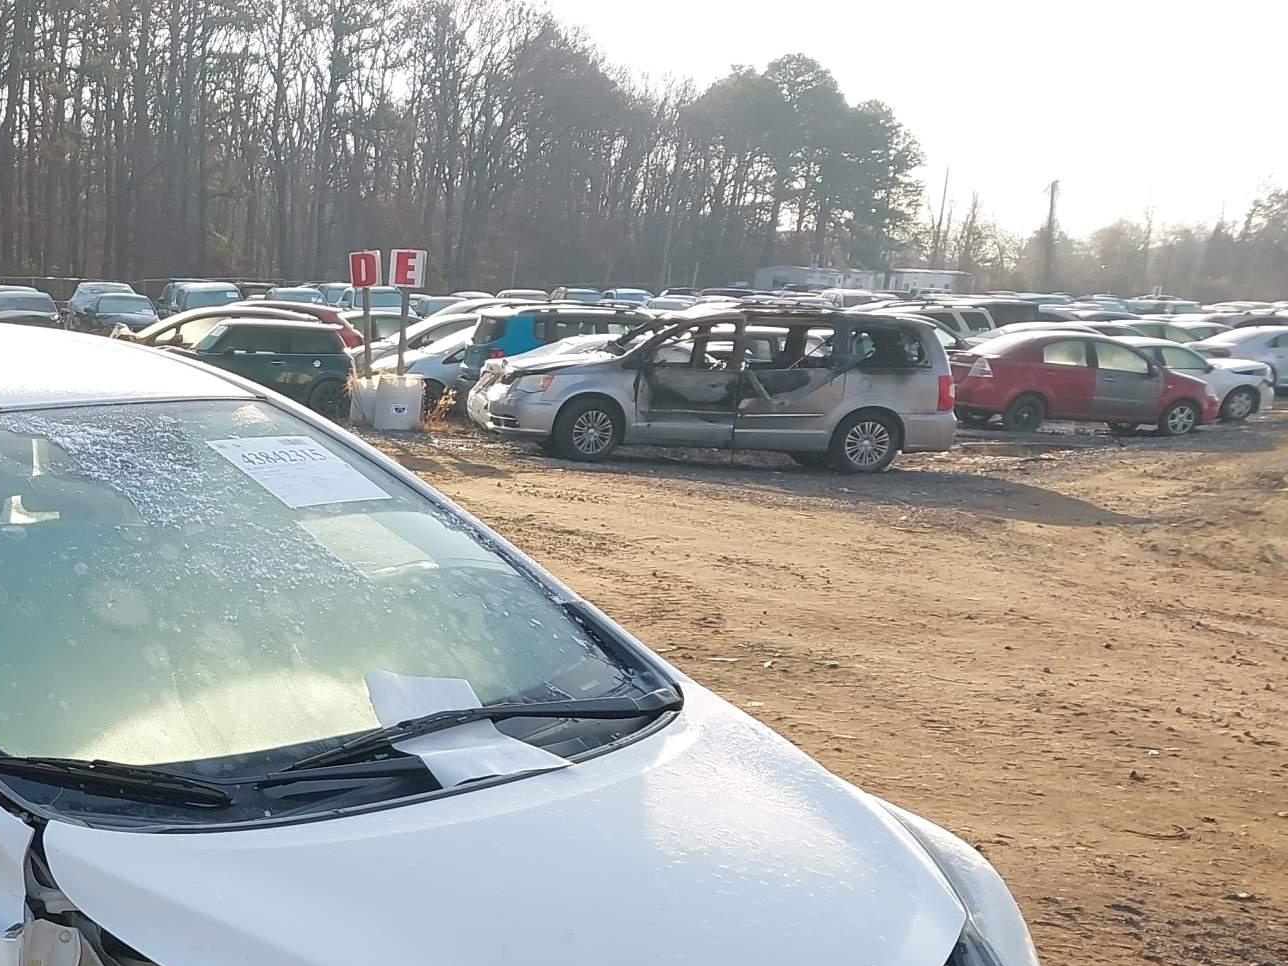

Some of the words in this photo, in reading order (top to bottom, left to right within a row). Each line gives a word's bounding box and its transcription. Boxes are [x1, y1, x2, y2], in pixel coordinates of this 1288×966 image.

[351, 253, 377, 287] D
[395, 252, 417, 285] E
[240, 448, 328, 466] 43842315
